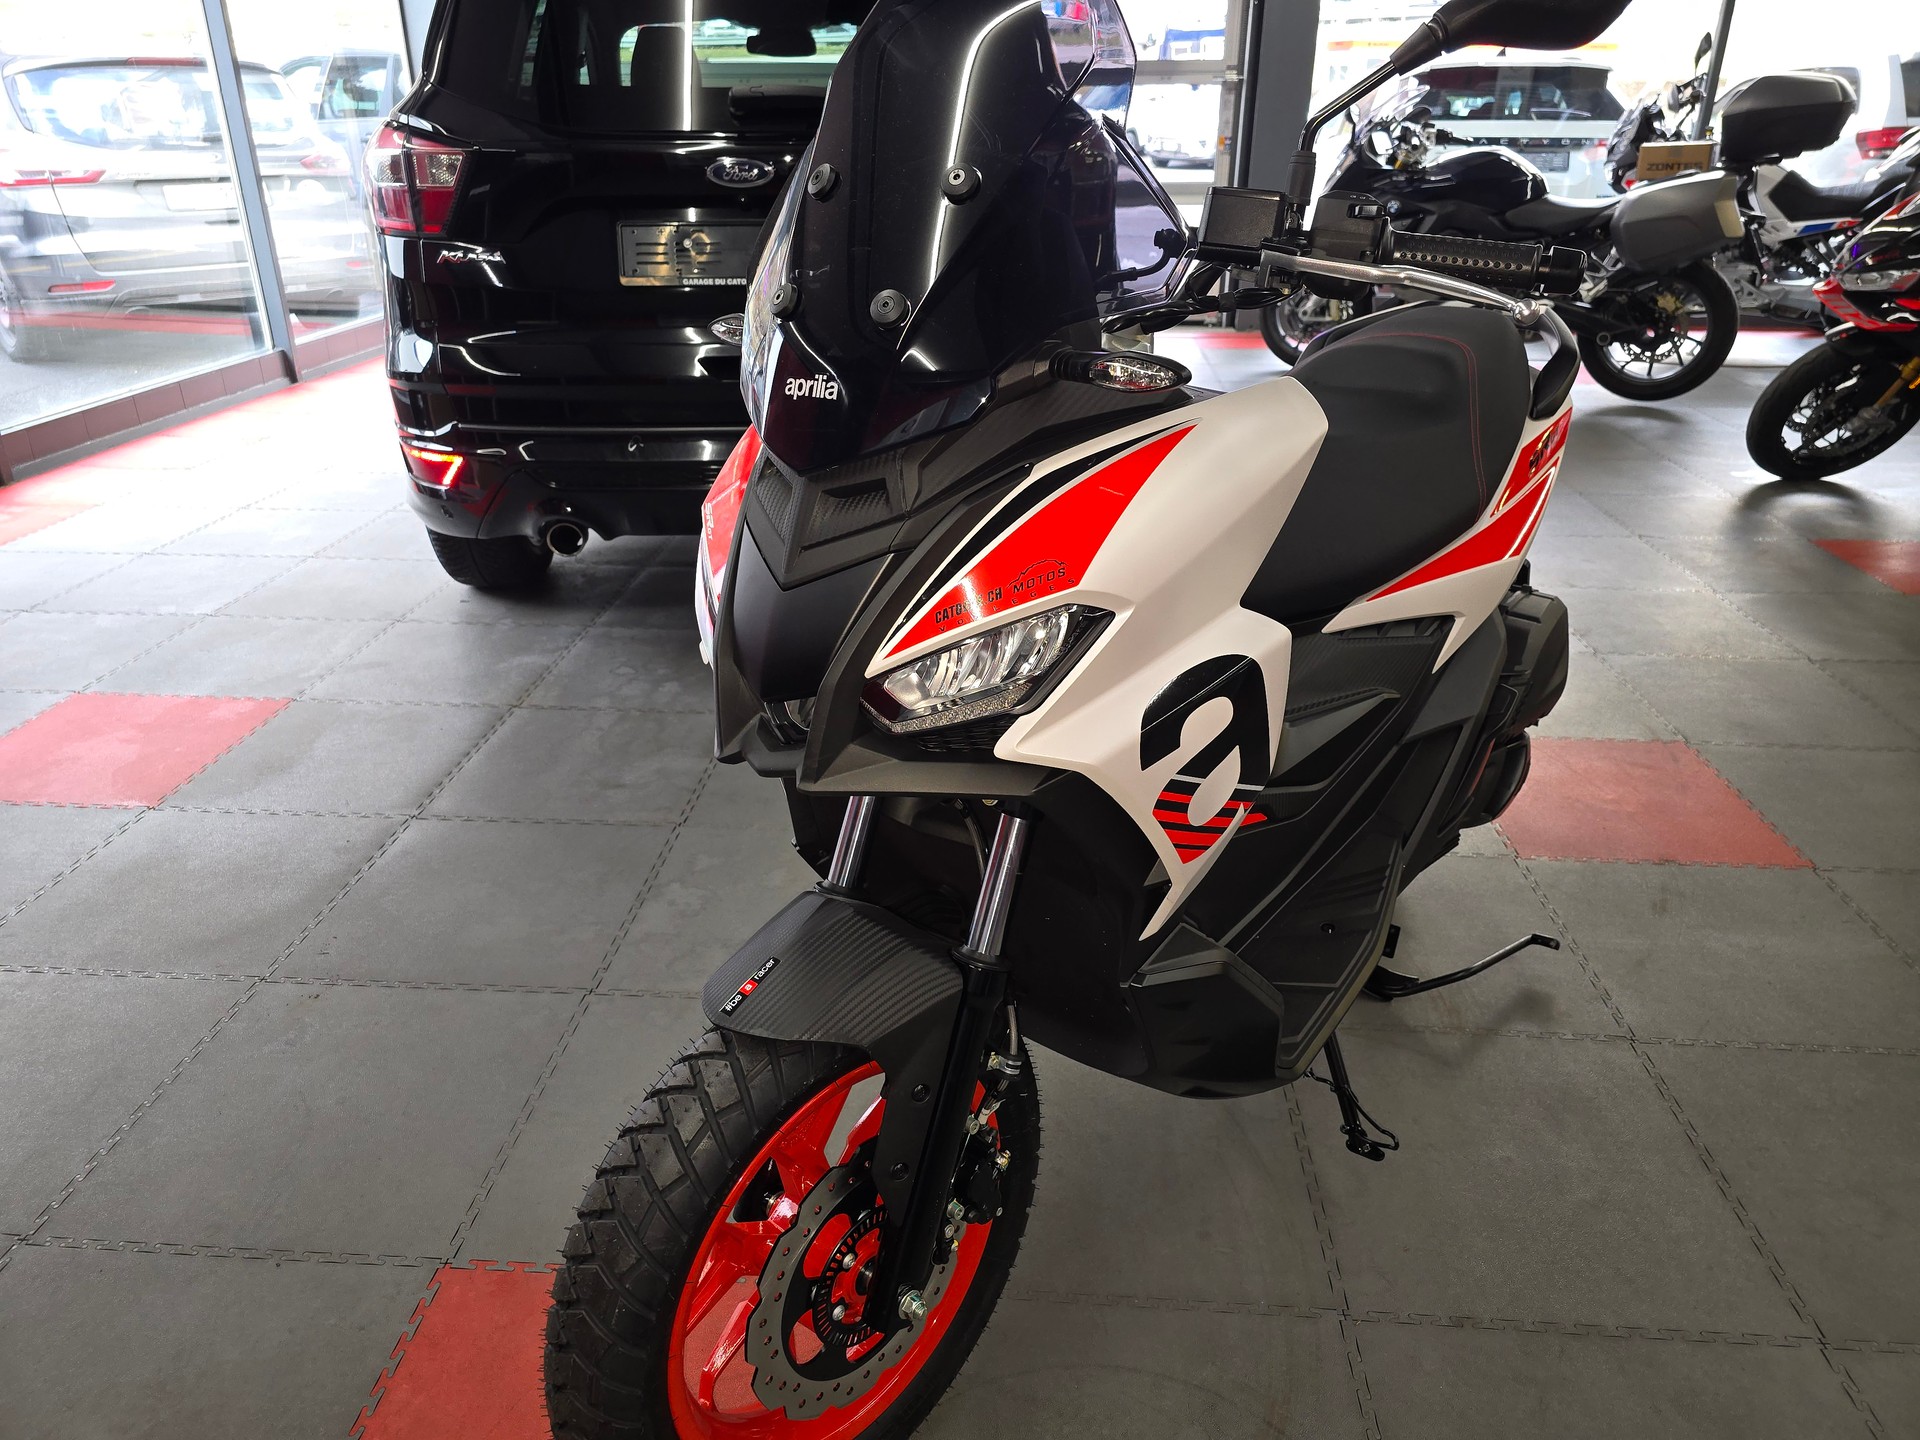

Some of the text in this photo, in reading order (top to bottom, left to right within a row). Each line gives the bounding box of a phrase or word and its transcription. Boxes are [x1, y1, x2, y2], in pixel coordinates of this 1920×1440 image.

[723, 163, 760, 181] Ford
[1646, 162, 1704, 172] ZONTES
[682, 278, 714, 286] GARAGE
[714, 278, 726, 286] DU
[784, 373, 839, 400] aprilia
[1013, 567, 1067, 594] MOTOS
[724, 958, 775, 1012] #be a racer
